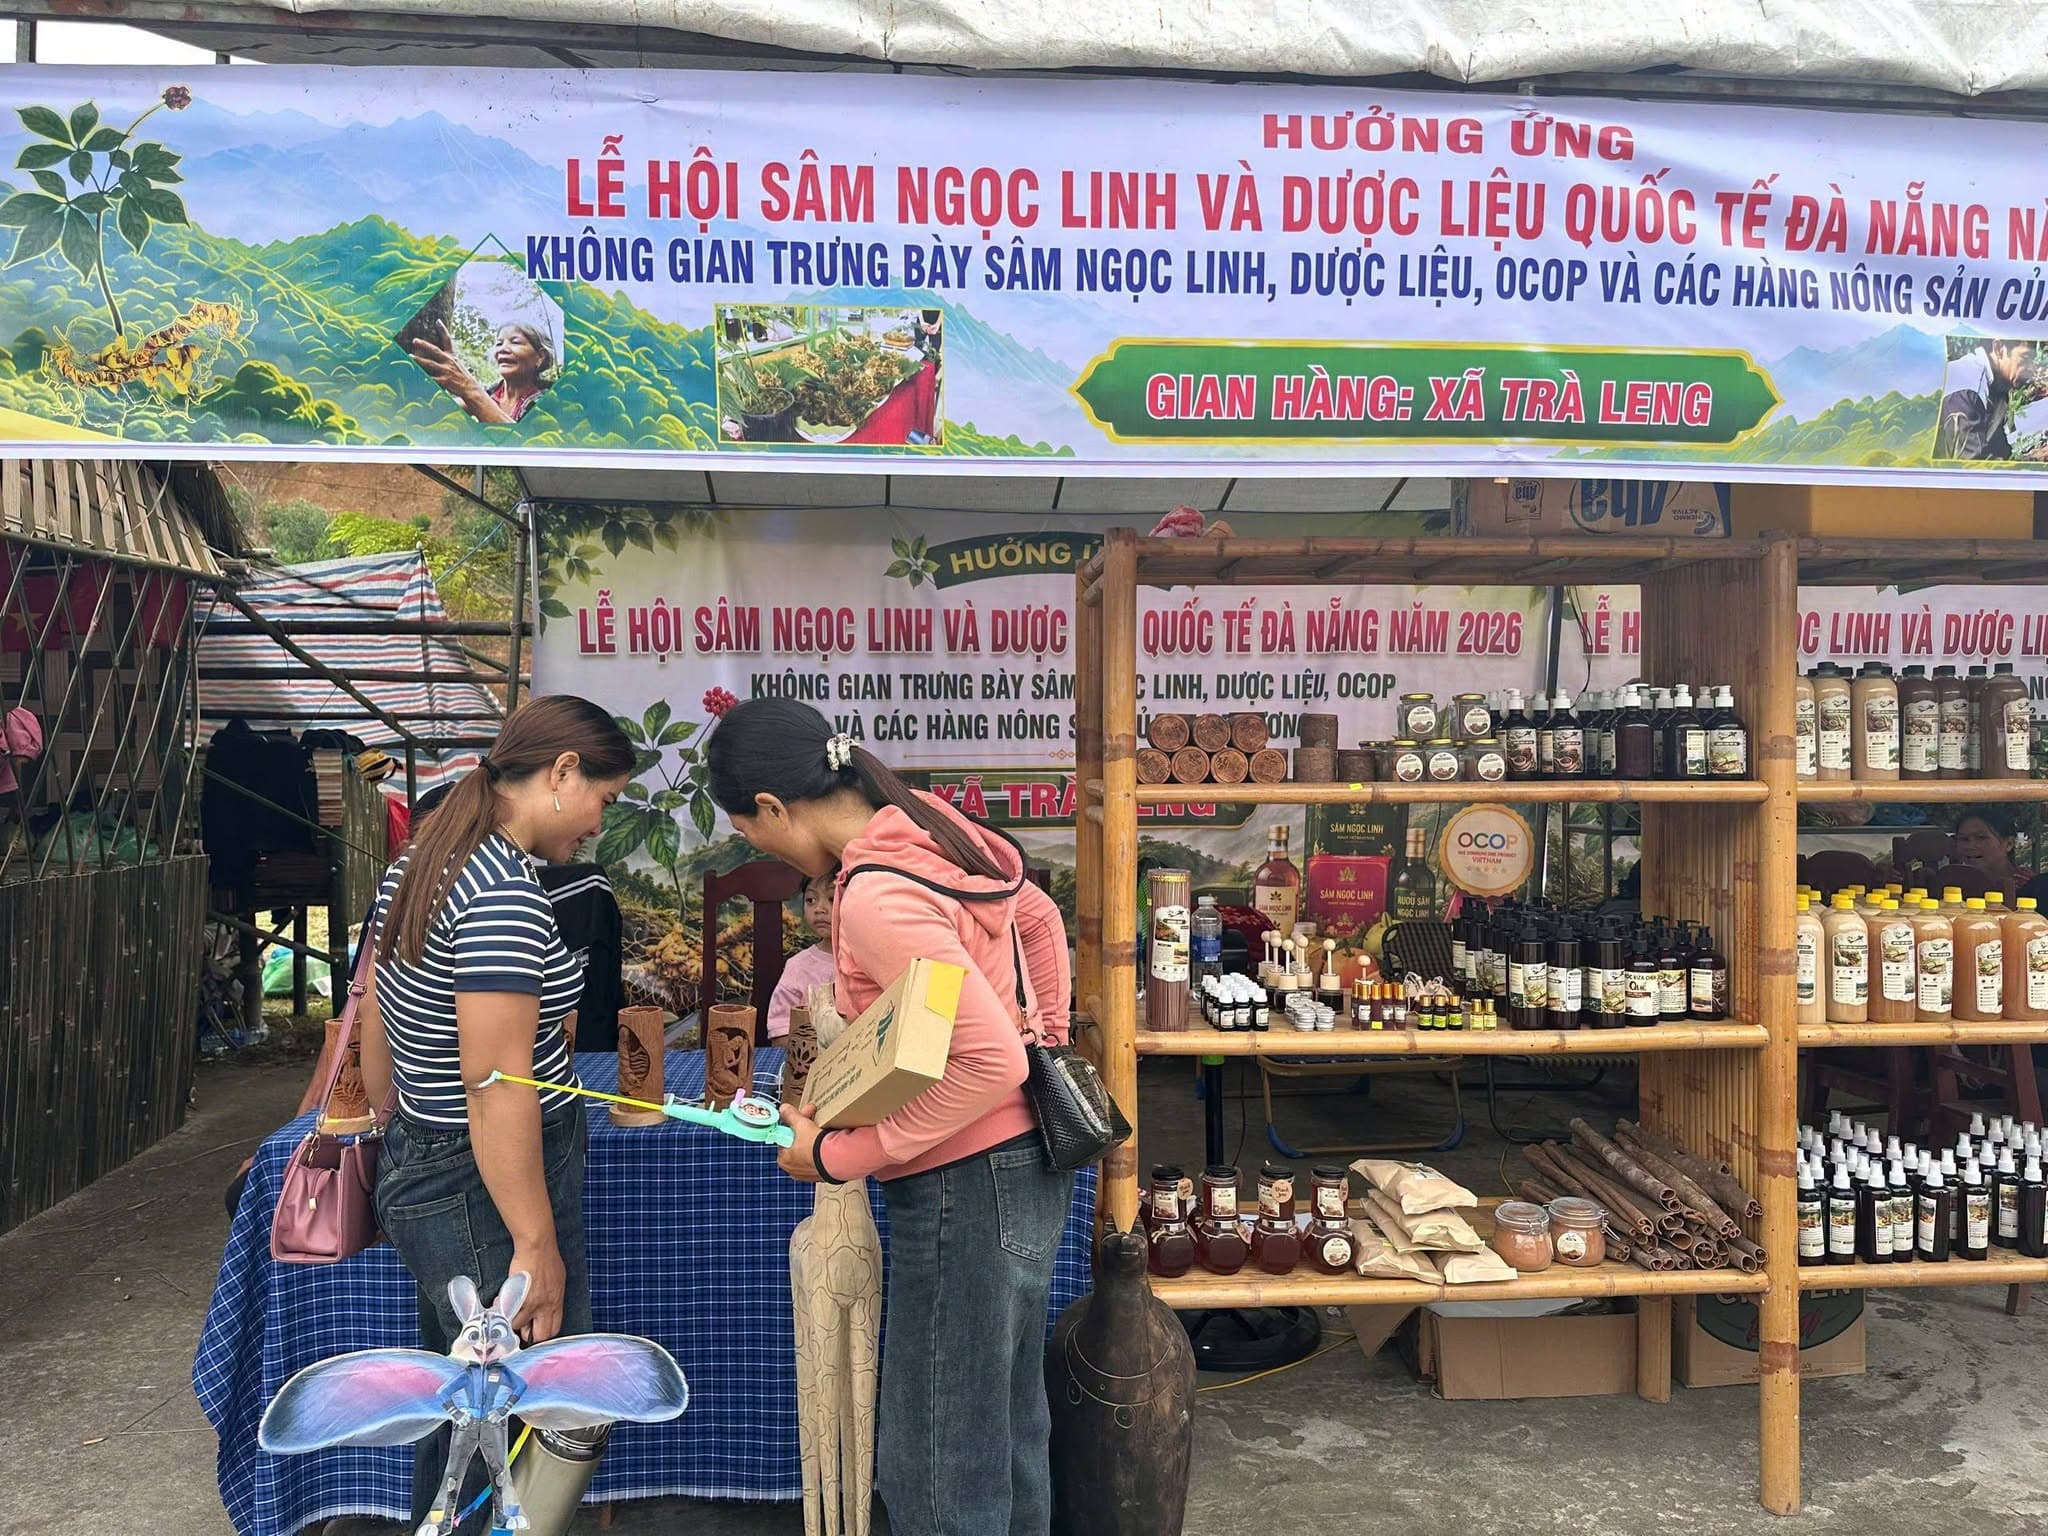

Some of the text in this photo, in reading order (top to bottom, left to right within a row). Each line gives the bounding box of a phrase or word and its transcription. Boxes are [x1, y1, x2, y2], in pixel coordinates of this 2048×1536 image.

[1264, 107, 1633, 160] HƯỞNG ỨNG
[568, 136, 625, 217] LỄ
[648, 147, 738, 233] HỘI
[761, 149, 874, 222] SÂM
[898, 167, 1039, 240] NGỌC
[1062, 171, 1176, 230] LINH
[1198, 161, 1262, 231] VÀ
[1283, 170, 1419, 247] DƯỢC
[1441, 168, 1545, 250] LIỆU
[1566, 169, 1696, 246] QUỐC
[1716, 175, 1780, 248] TẾ
[1786, 186, 1847, 251] ĐÀ
[1867, 183, 1988, 258] NẴNG
[526, 226, 653, 283] KHÔNG
[669, 239, 753, 283] GIAN
[767, 236, 889, 287] TRƯNG
[903, 234, 972, 289] BÀY
[985, 236, 1061, 290] SÂM
[1077, 248, 1171, 302] NGỌC
[1187, 251, 1276, 302] LINH,
[1291, 247, 1384, 299] DƯỢC
[1399, 245, 1482, 307] LIỆU,
[1497, 257, 1587, 301] OCOP
[1600, 251, 1640, 303] VÀ
[1655, 253, 1720, 306] CÁC
[1733, 257, 1818, 308] HÀNG
[1831, 263, 1912, 313] NÔNG
[1924, 264, 1990, 318] SẢN
[1148, 368, 1710, 424] GIAN HÀNG: XÃ TRÀ LENG
[951, 537, 1071, 574] HƯỞNG
[580, 590, 1522, 664] LỄ HỘI SÂM NGỌC LINH VÀ DƯỢC QUỐC TẾ ĐÀ NẴNG NĂM 2026
[1580, 596, 1610, 651] LỄ
[1829, 613, 1890, 656] LINH
[1902, 604, 1931, 656] VÀ
[1943, 612, 2013, 665] DƯỢC
[751, 668, 829, 700] KHÔNG
[839, 674, 891, 700] GIAN
[900, 672, 972, 699] TRƯNG
[982, 668, 1024, 699] BÀY
[1032, 669, 1075, 700] SÂM
[1154, 675, 1207, 703] LINH,
[1216, 672, 1273, 705] DƯỢC
[1282, 669, 1328, 704] LIỆU,
[1338, 673, 1395, 698] OCOP
[834, 709, 865, 740] VÀ
[874, 709, 917, 741] CÁC
[927, 709, 988, 740] HÀNG
[998, 709, 1059, 739] NÔNG
[931, 778, 986, 819] XÃ
[1458, 832, 1518, 849] OCOP
